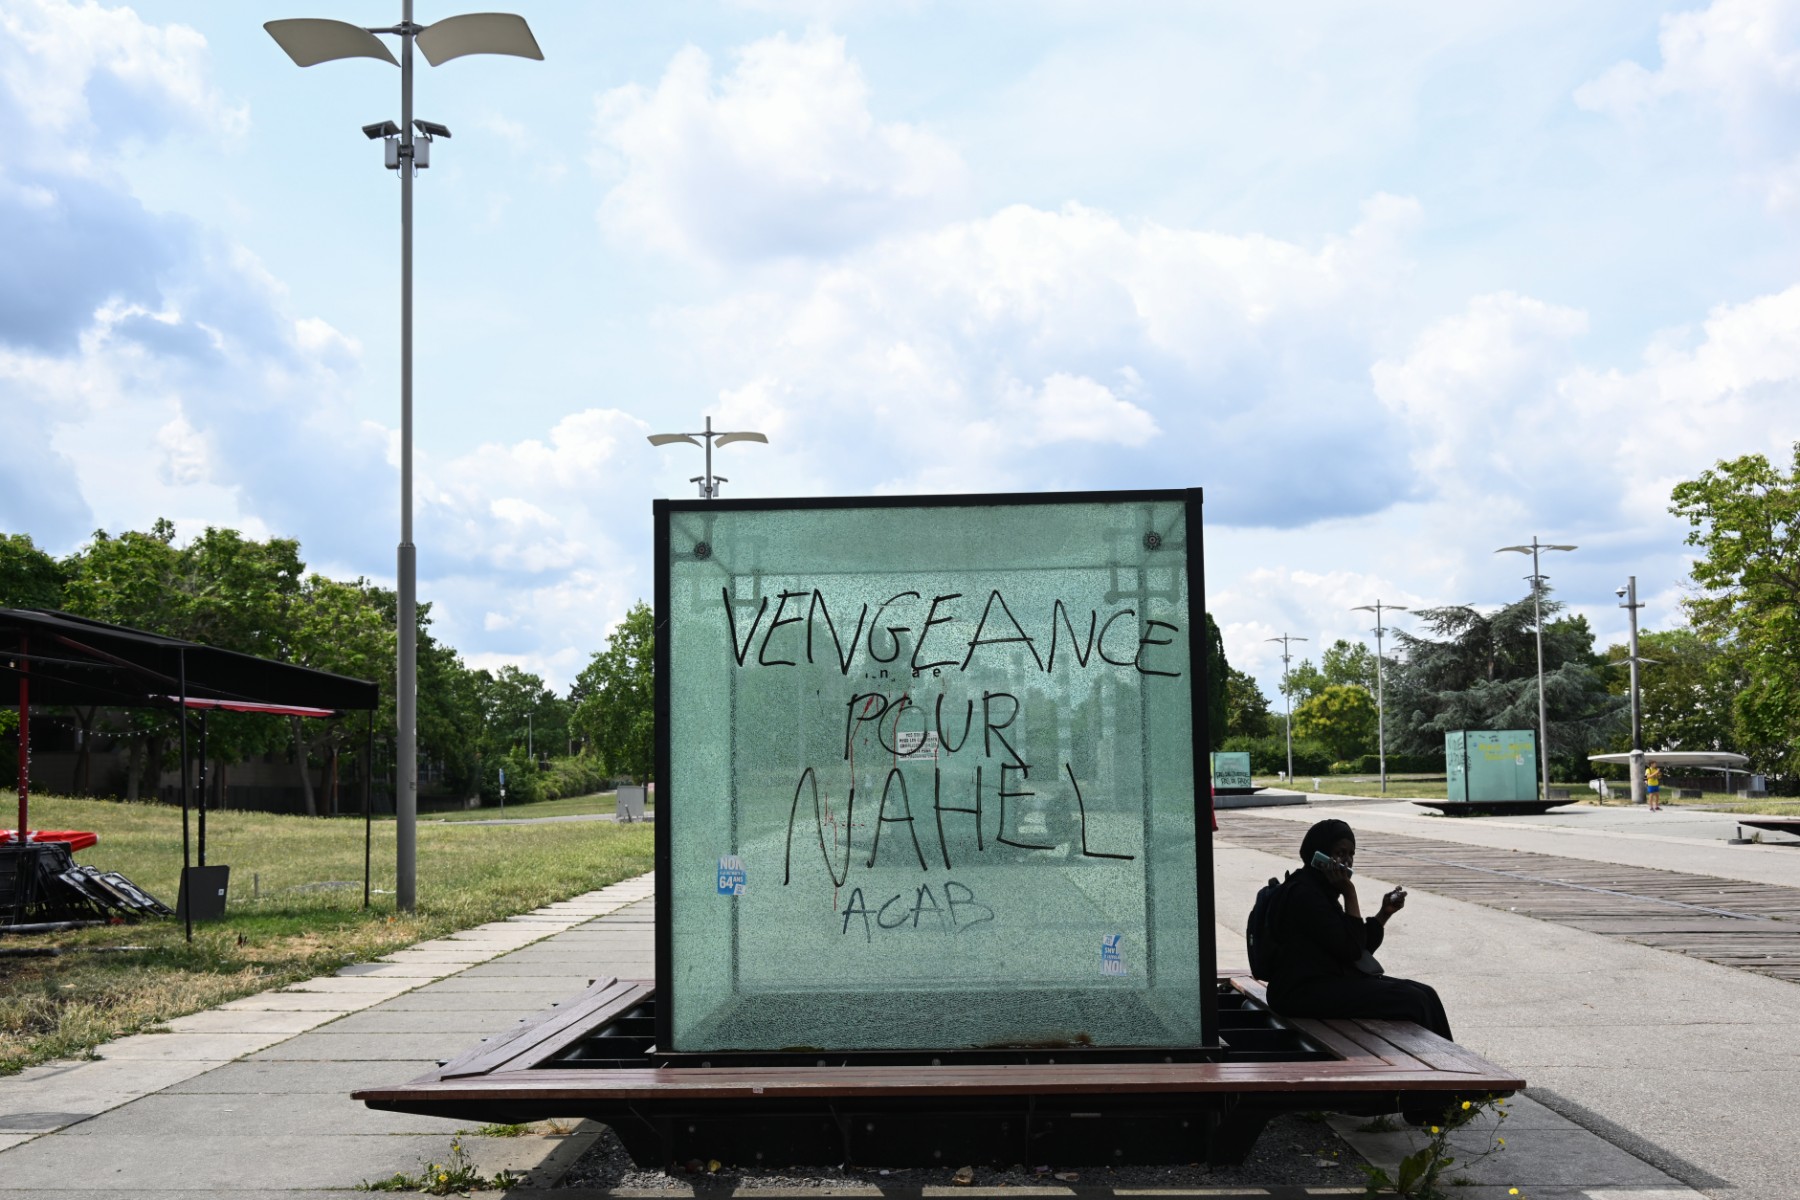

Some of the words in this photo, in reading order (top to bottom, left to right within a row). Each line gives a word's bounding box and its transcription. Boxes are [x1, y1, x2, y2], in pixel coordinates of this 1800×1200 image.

[722, 587, 1183, 677] VENGEANCE
[844, 690, 1032, 779] POUR
[782, 762, 1136, 887] NAHEL
[719, 875, 733, 888] 64
[842, 881, 995, 943] ACAB
